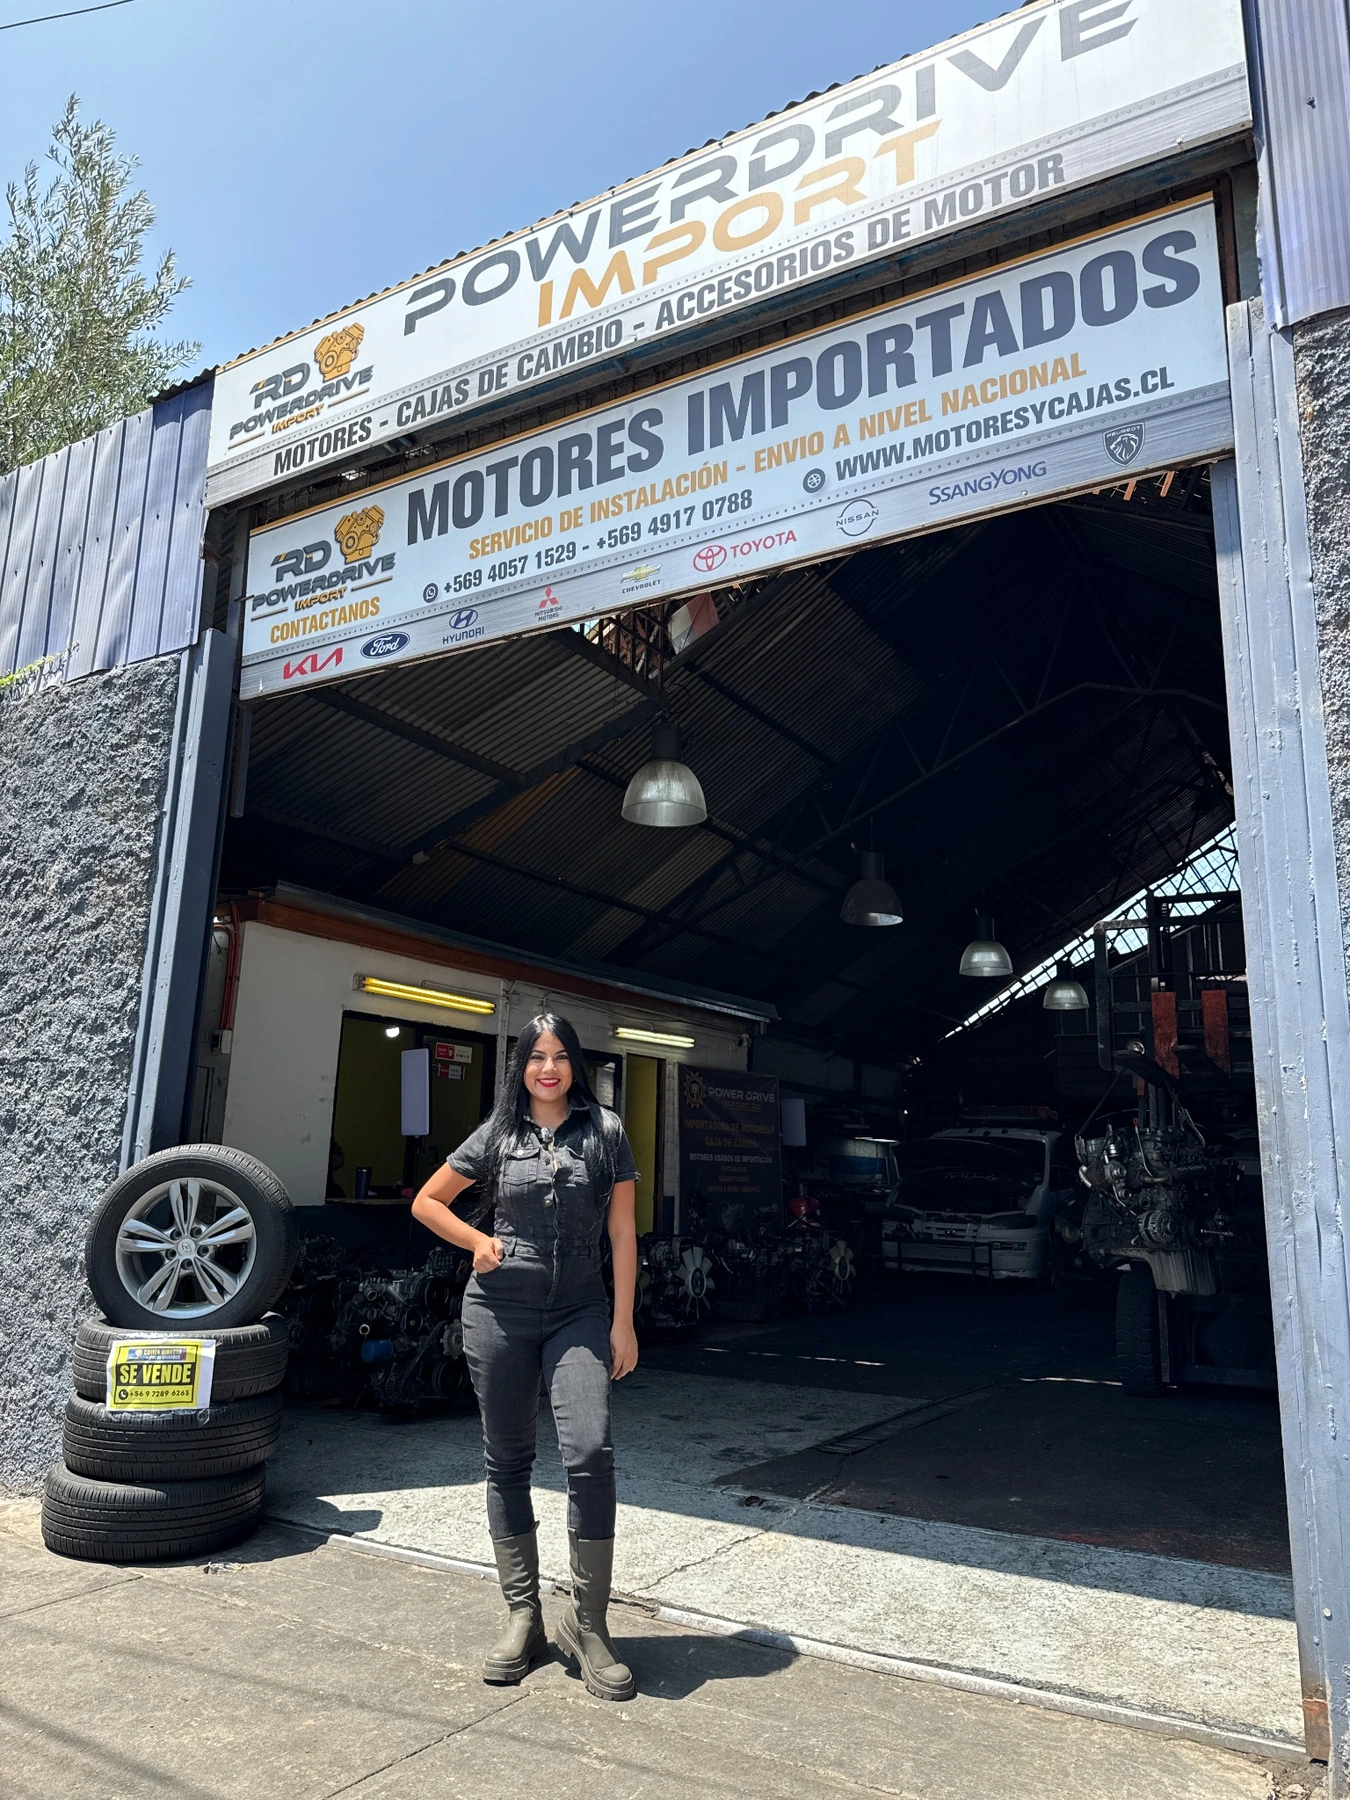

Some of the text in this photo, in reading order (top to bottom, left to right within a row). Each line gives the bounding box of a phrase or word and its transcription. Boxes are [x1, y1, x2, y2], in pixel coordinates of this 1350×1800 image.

[404, 0, 1139, 336] POWERDRIVE
[538, 119, 943, 327] IMPORT
[273, 416, 372, 476] MOTORES
[396, 378, 469, 427] CAJAS
[477, 363, 508, 395] DE
[517, 319, 623, 382] CAMBIO
[655, 230, 854, 331] ACCESORIOS
[867, 207, 911, 251] DE
[924, 153, 1065, 231] MOTOR
[407, 230, 1200, 546] MOTORES IMPORTADOS
[229, 364, 374, 440] POWERDRIVE
[271, 403, 324, 434] IMPORT
[835, 366, 1175, 481] WWW.MOTORESYCAJAS.CL
[1106, 425, 1141, 438] PEUGEOT
[468, 516, 553, 560] SERVICIO
[560, 506, 583, 533] DE
[590, 460, 728, 523] INSTALACIÓN
[755, 431, 825, 474] ENVIO
[833, 423, 850, 450] A
[859, 399, 932, 441] NIVEL
[941, 352, 1087, 416] NACIONAL
[836, 508, 879, 527] NISSAN
[444, 568, 482, 593] +569
[487, 554, 528, 582] 4057
[535, 541, 577, 569] 1529
[597, 522, 641, 549] +569
[647, 505, 695, 536] 4917
[702, 488, 753, 521] 0788
[730, 529, 797, 558] TOYOTA
[250, 552, 397, 611] POWERDRIVE
[622, 578, 662, 594] CHEVROLET
[294, 586, 347, 611] IMPORT
[270, 596, 381, 644] CONTACTANOS
[534, 605, 563, 618] MITSUBISHI
[538, 612, 559, 622] MOTORS
[369, 636, 399, 655] Ford
[442, 626, 485, 645] HYUNDAI
[283, 647, 343, 680] KIA
[708, 1086, 775, 1103] POWER DRIVE
[723, 1100, 749, 1109] IMPORT
[684, 1118, 730, 1131] IMPORTADORA
[731, 1123, 740, 1132] DE
[741, 1123, 770, 1134] MOTORES
[705, 1137, 722, 1146] CAJA
[723, 1138, 732, 1147] DE
[689, 1153, 713, 1161] MOTORES
[714, 1154, 733, 1162] USADOS
[119, 1363, 192, 1384] SE VENDE
[151, 1389, 169, 1397] 7289
[171, 1389, 190, 1397] 6263
